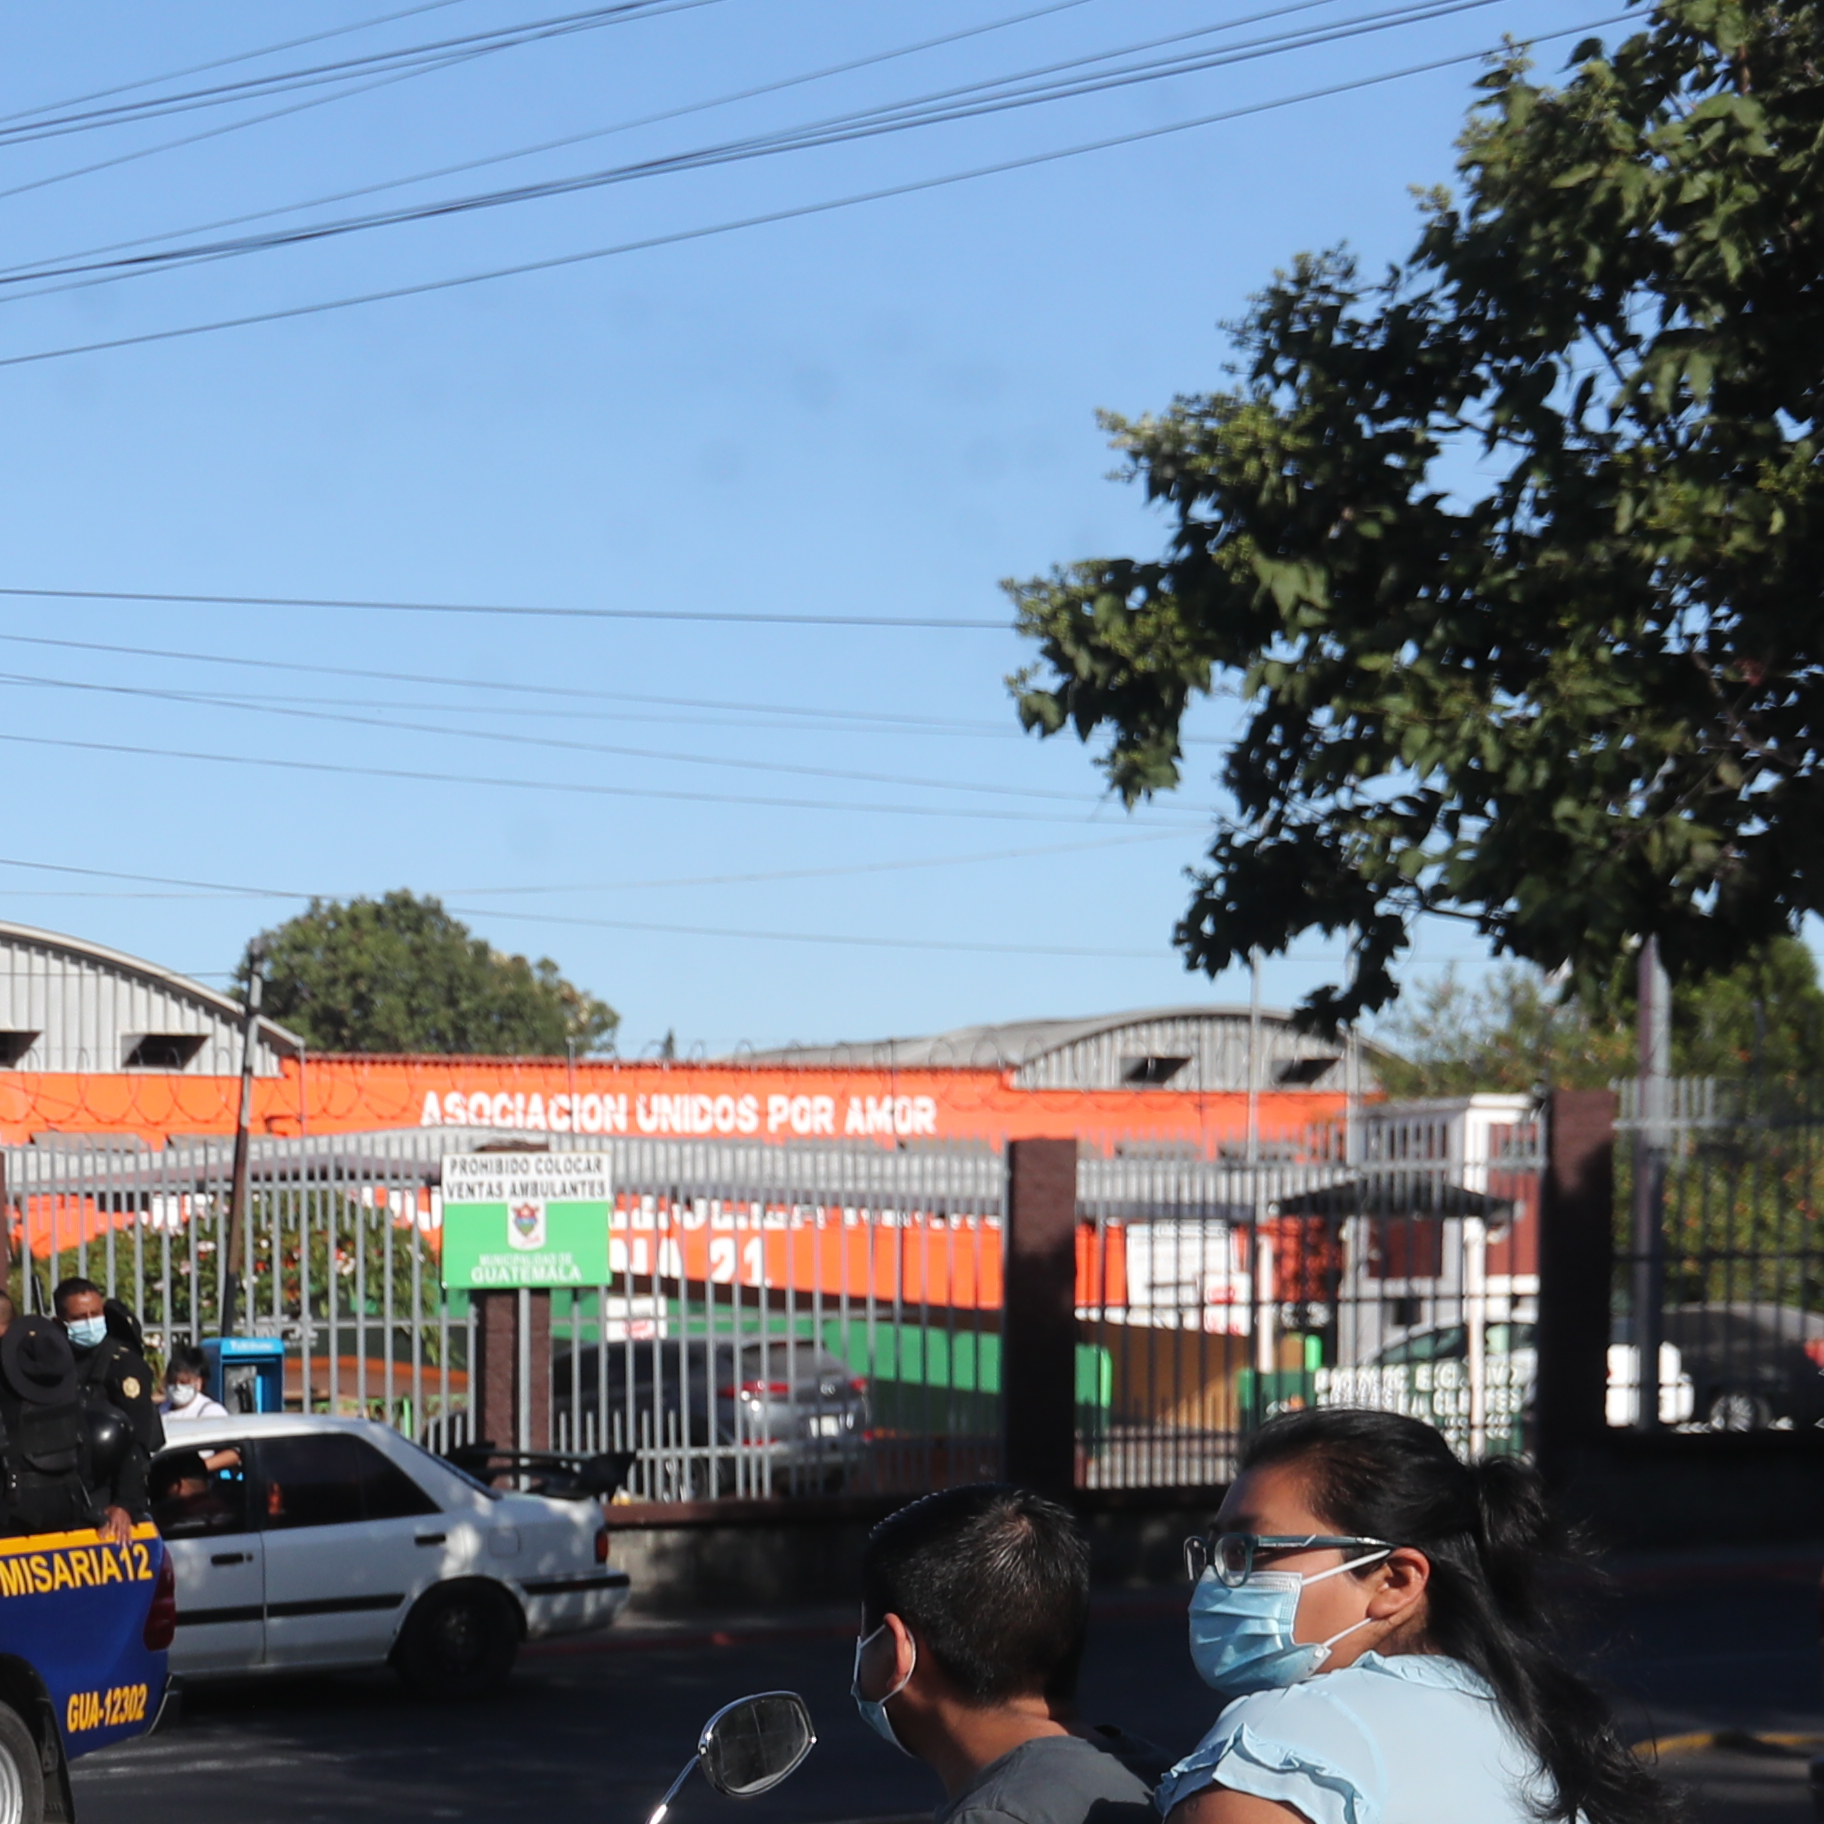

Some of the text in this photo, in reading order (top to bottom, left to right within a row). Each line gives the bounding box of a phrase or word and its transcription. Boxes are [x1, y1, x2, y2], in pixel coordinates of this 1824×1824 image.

[419, 1091, 937, 1135] ASOCIACION UNIDOS POR AMOR
[450, 1156, 603, 1175] PROHIBIDO COLOCAR
[447, 1179, 606, 1199] VENTAS AMBULANTES
[470, 1265, 582, 1285] GUATEMALA
[67, 1683, 148, 1734] GUA-12302
